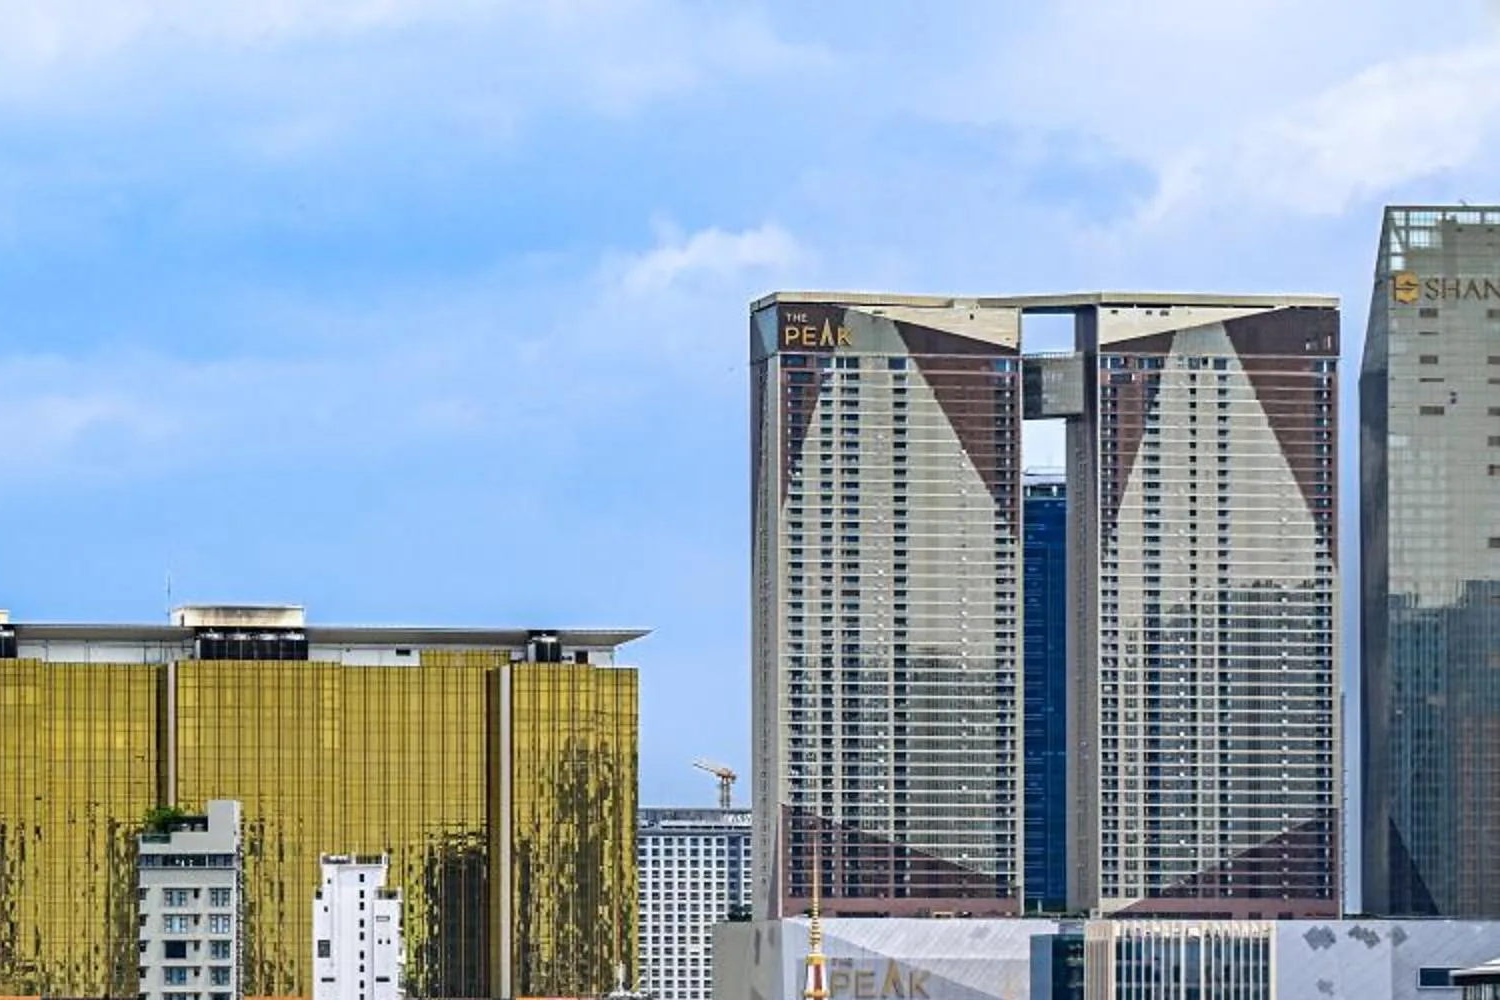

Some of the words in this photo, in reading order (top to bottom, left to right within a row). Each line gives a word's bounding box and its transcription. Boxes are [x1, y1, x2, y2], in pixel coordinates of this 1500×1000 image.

[1425, 278, 1500, 300] SHAN
[785, 312, 809, 323] THE
[785, 317, 853, 347] PEAK
[830, 957, 931, 1000] PEAK
